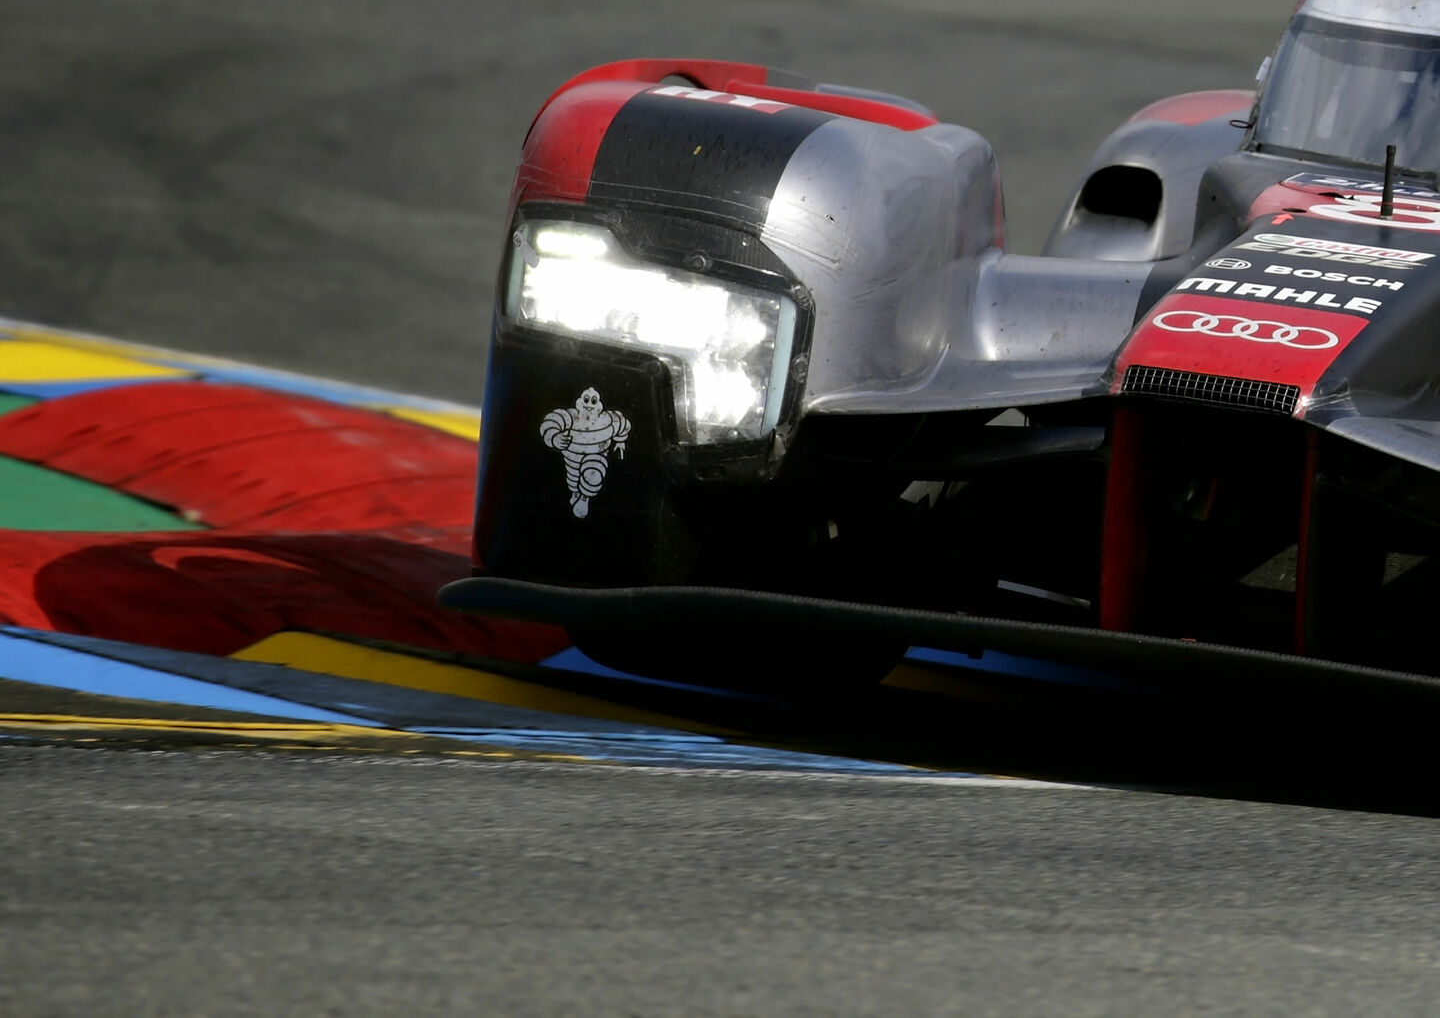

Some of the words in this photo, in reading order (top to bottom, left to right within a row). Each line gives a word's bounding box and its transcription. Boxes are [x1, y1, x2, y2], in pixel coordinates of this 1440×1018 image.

[1233, 242, 1428, 270] EDGE
[1291, 238, 1421, 261] Castrol
[1264, 264, 1405, 291] BOSCH
[1176, 277, 1383, 315] MAHLE
